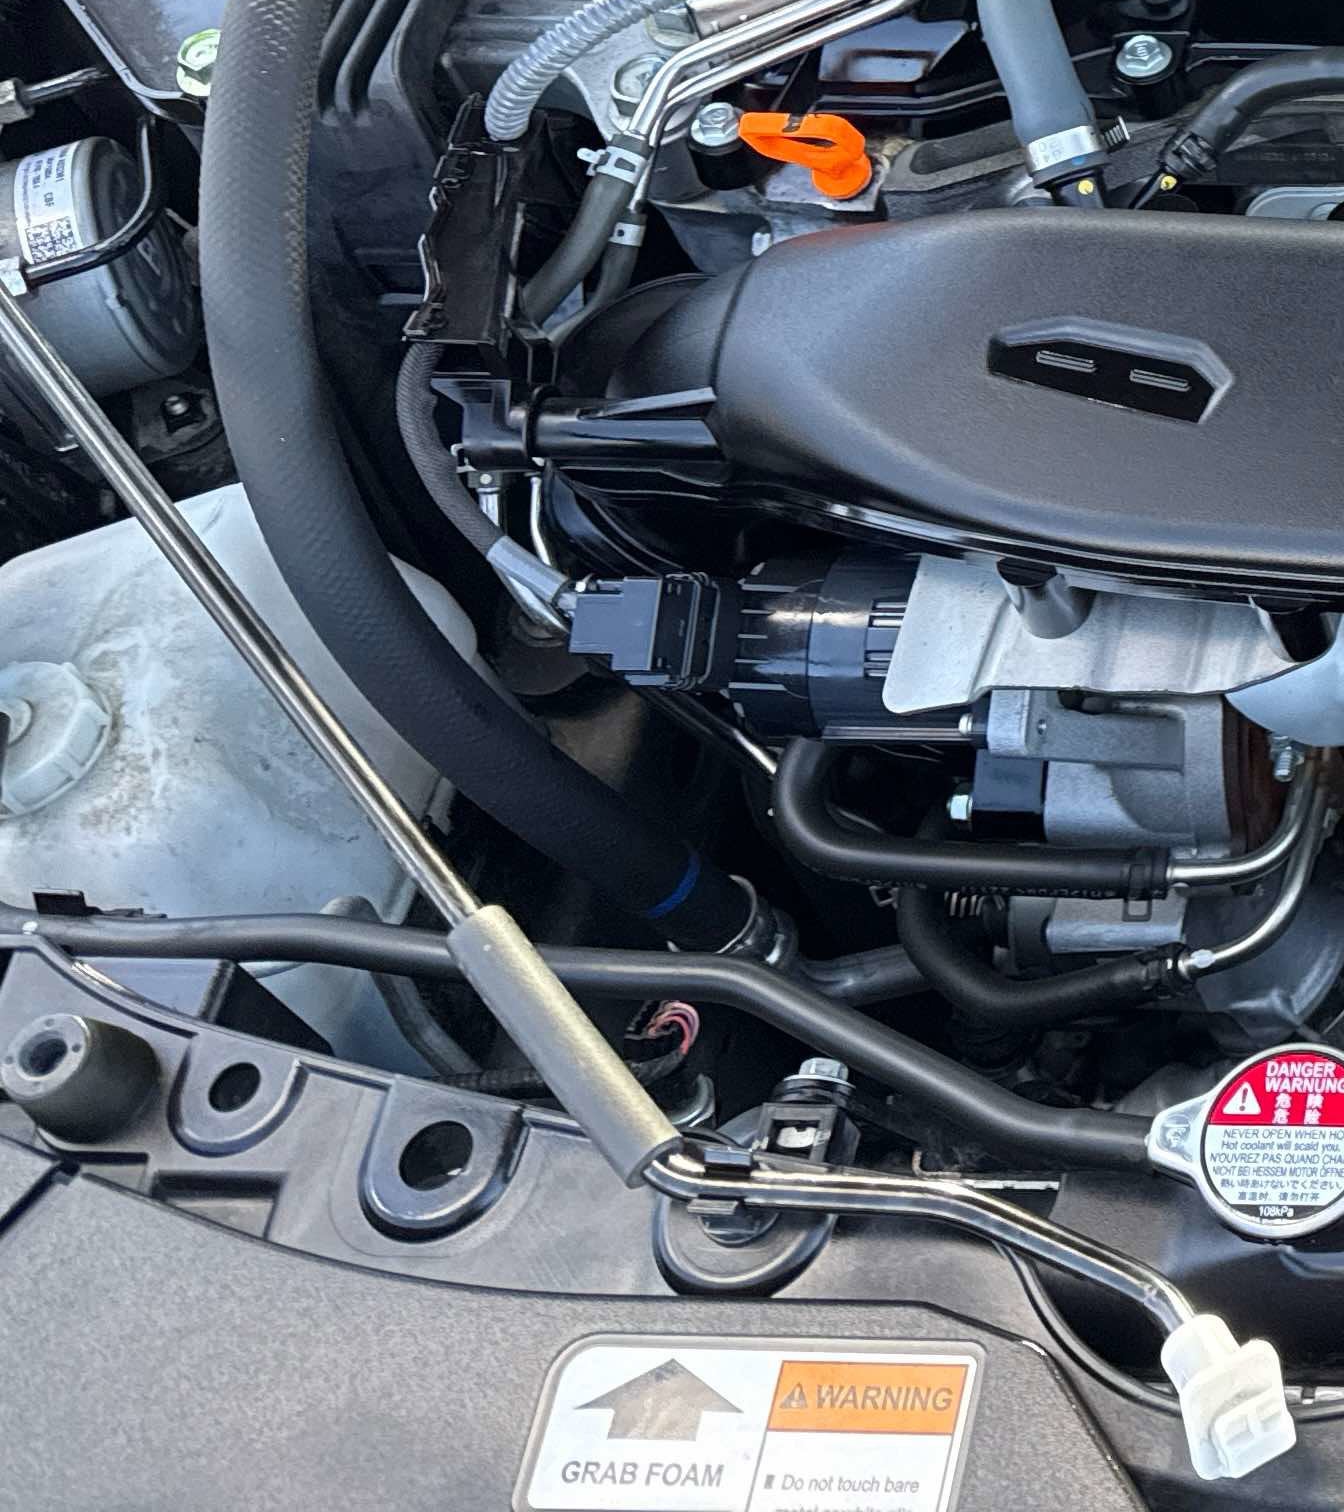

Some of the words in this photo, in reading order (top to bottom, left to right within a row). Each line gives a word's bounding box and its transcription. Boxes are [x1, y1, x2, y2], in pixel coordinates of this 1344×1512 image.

[1266, 1061, 1336, 1078] DANGER
[1223, 1129, 1260, 1138] NEVER
[1262, 1129, 1293, 1139] OPEN
[1295, 1129, 1326, 1139] WHEN
[1221, 1141, 1239, 1150] Hot
[1240, 1141, 1274, 1150] coolant
[1277, 1141, 1292, 1150] will
[1294, 1141, 1319, 1151] scald
[1321, 1143, 1341, 1153] you.
[1210, 1153, 1260, 1164] N'OUVREZ
[1262, 1153, 1282, 1164] PAS
[1284, 1154, 1320, 1164] QUAND
[1213, 1166, 1236, 1176] NICHT
[1289, 1167, 1319, 1177] MOTOR
[1258, 1206, 1295, 1218] 108kPa
[815, 1383, 954, 1413] WARNING
[561, 1460, 640, 1486] GRAB
[644, 1461, 725, 1488] FOAM
[781, 1474, 805, 1491] Do
[808, 1475, 834, 1492] not
[837, 1475, 881, 1493] touch
[884, 1475, 920, 1493] bare
